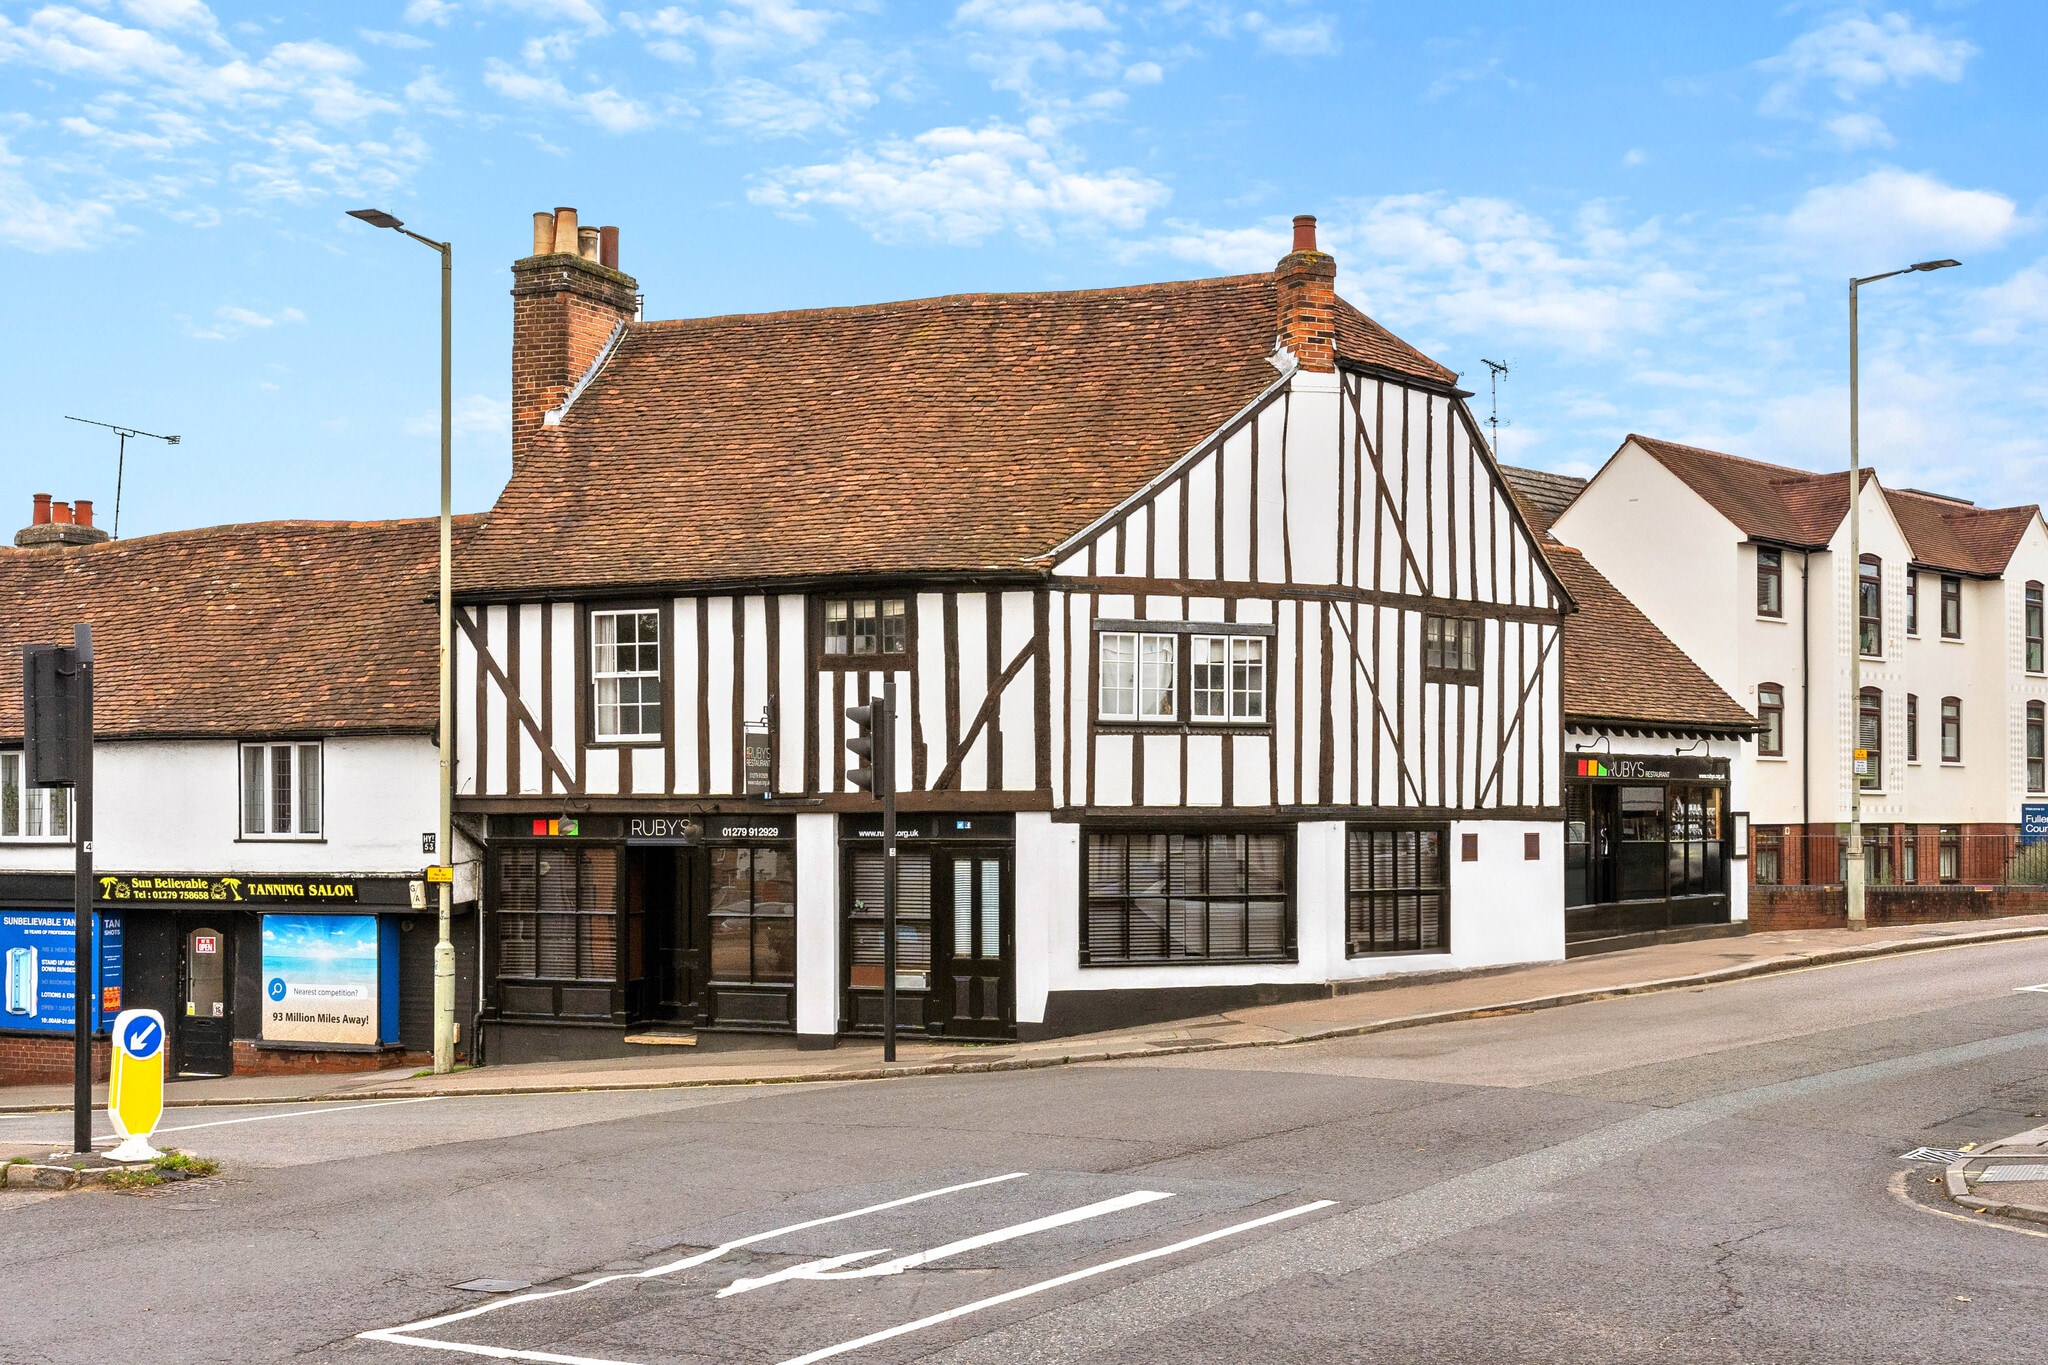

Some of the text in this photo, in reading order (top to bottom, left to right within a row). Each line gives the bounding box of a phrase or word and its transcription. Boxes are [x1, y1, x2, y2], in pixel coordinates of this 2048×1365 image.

[631, 819, 690, 836] RUBY'S
[722, 827, 779, 837] 01279 912929
[859, 830, 918, 838] www.ru.org.uk
[131, 878, 209, 889] Sun Believable
[133, 890, 147, 899] Tel
[152, 890, 178, 899] 01279
[179, 891, 209, 900] 758658
[248, 884, 354, 896] TANNING SALON
[4, 917, 61, 926] SUNBELIEVABLE
[104, 920, 120, 928] TAN
[293, 988, 359, 998] Nearest competition?
[272, 1012, 369, 1027] 93 Million Miles Away!
